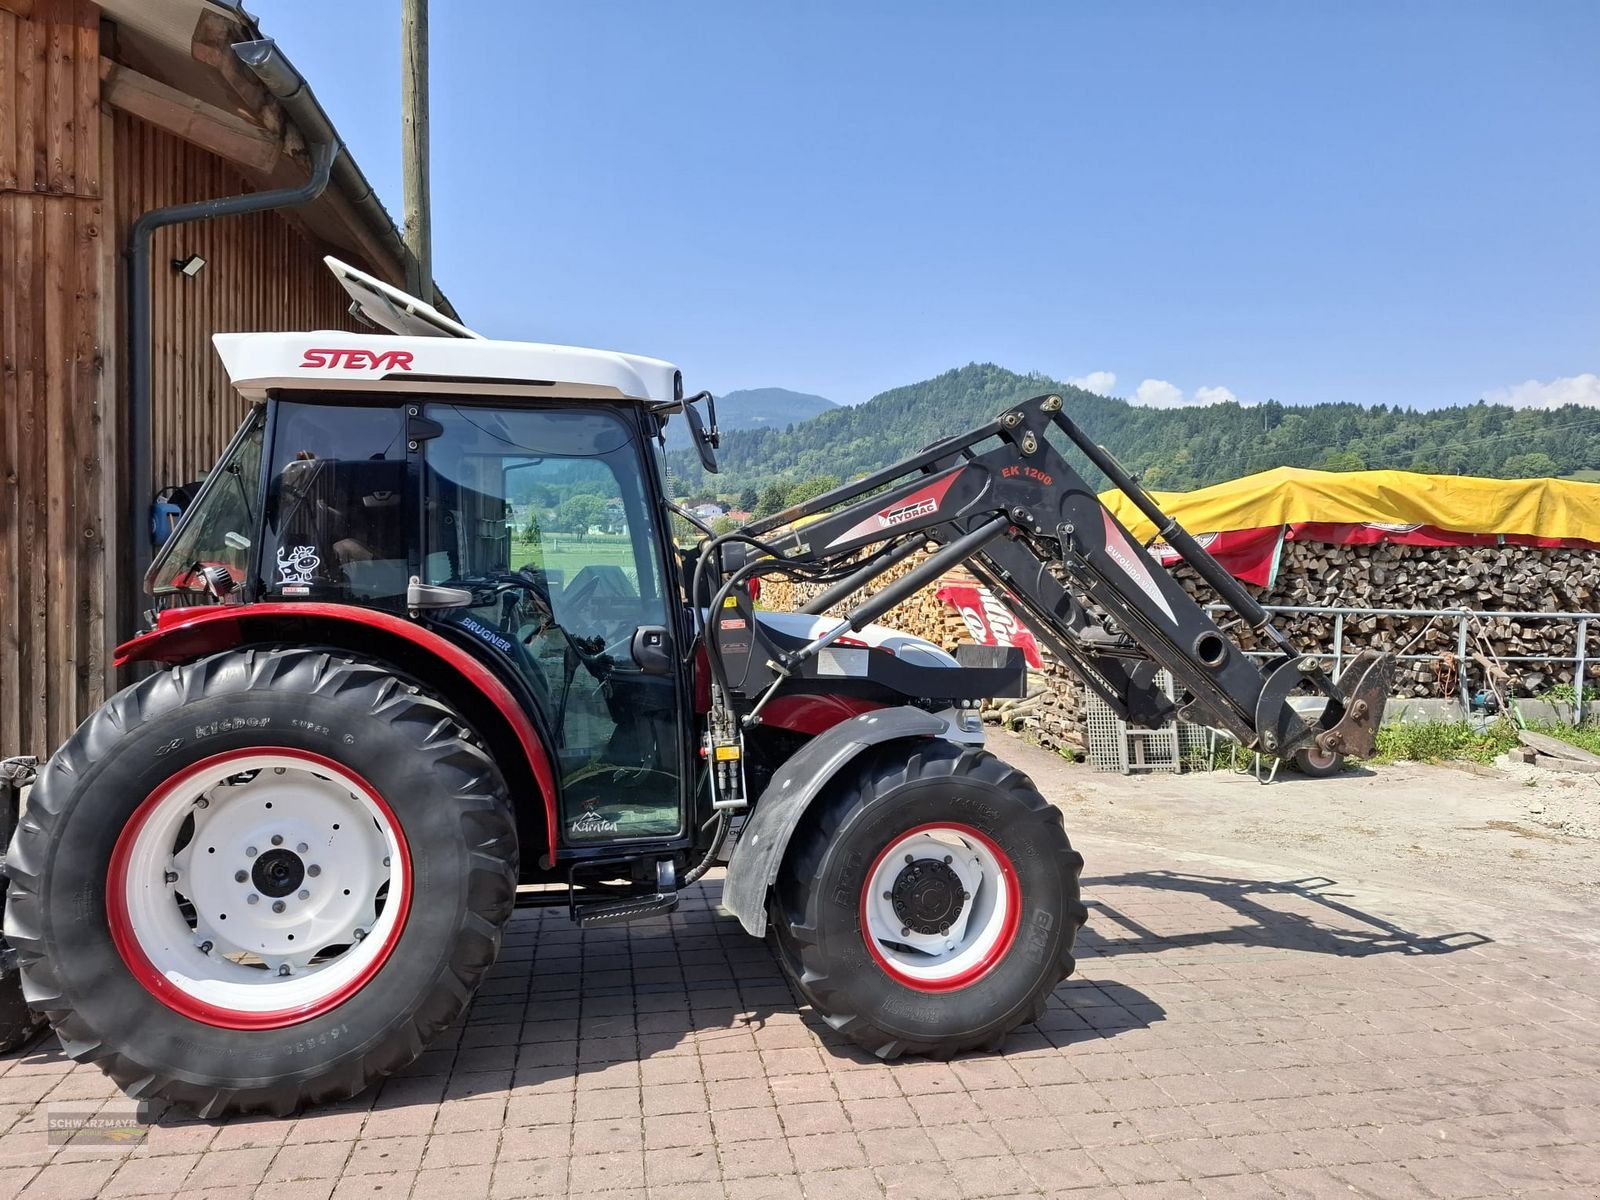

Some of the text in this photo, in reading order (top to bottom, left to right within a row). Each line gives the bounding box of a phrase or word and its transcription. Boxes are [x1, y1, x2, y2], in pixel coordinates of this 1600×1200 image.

[299, 348, 414, 371] STEYR
[1001, 465, 1053, 486] EK 1200
[888, 504, 935, 525] HYDRAC
[460, 617, 512, 652] BRUGNER
[571, 819, 618, 833] Kärnten
